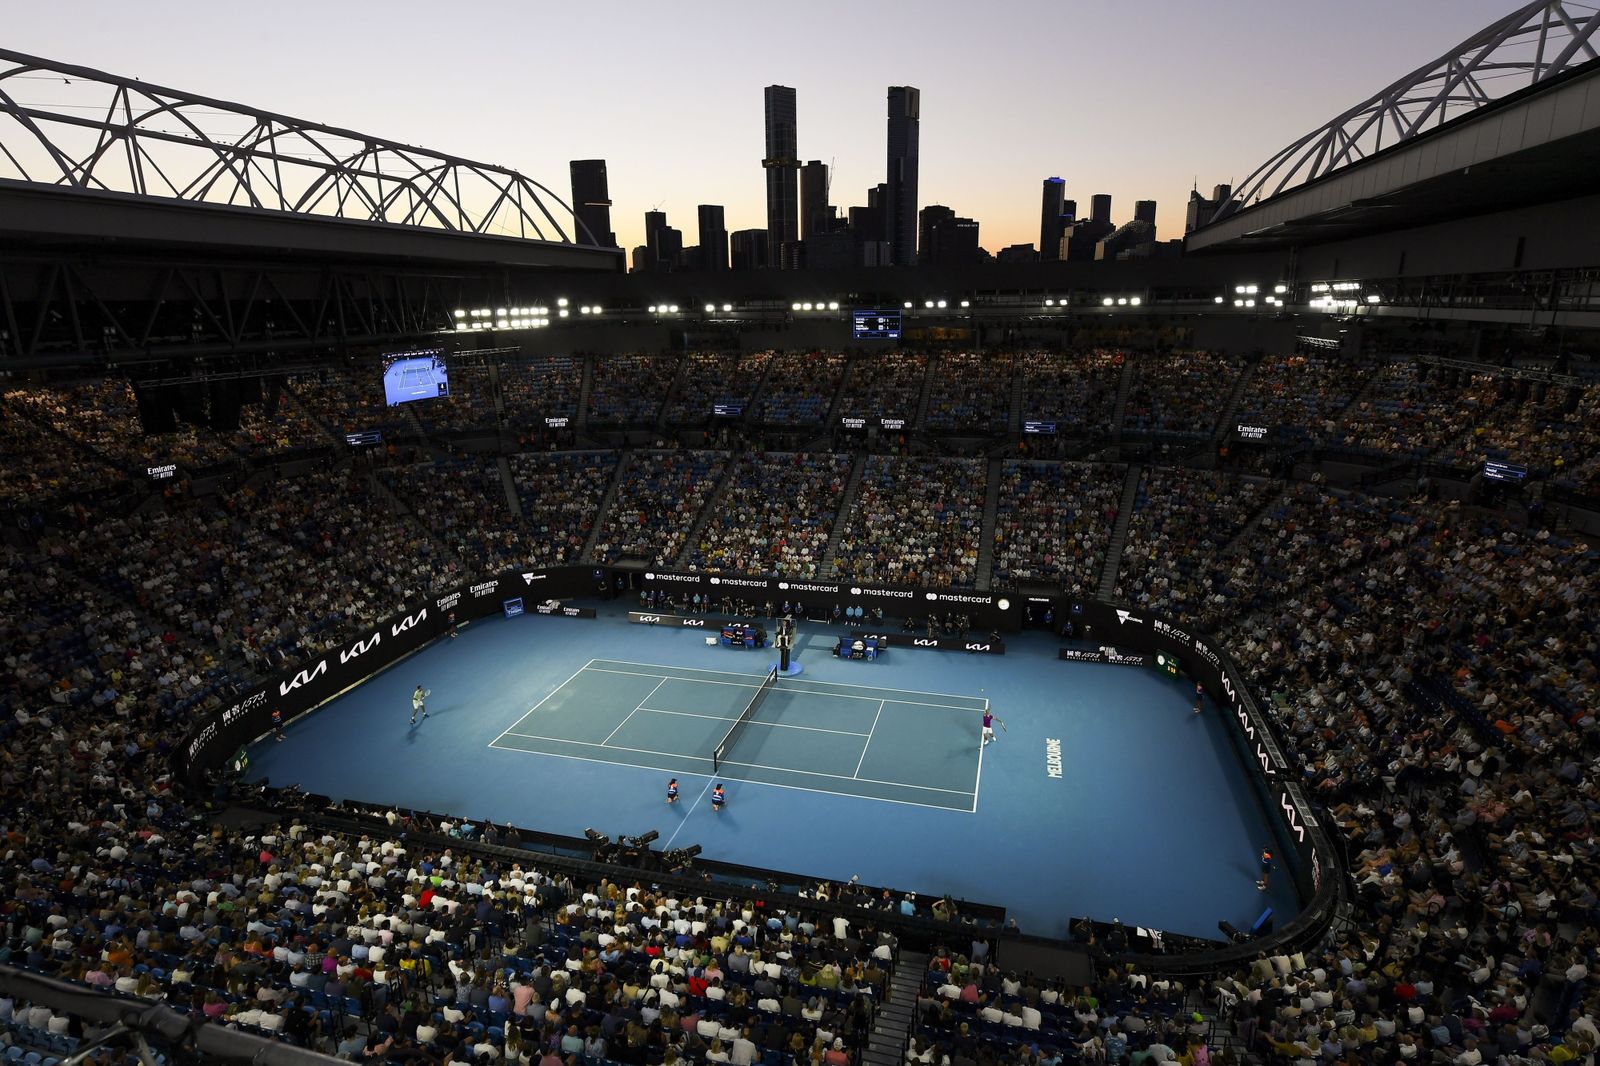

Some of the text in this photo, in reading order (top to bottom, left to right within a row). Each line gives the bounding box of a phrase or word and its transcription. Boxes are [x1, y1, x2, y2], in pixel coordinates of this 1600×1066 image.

[1237, 425, 1268, 434] Emirates
[147, 464, 177, 475] Emirates
[656, 573, 700, 582] mastercard
[722, 578, 767, 587] mastercard
[470, 580, 499, 593] Emirates
[790, 583, 838, 592] mastercard
[863, 588, 913, 598] mastercard
[939, 593, 991, 603] mastercard
[436, 592, 461, 607] Emirates
[392, 608, 427, 637] KIA
[640, 615, 660, 623] KIA
[340, 632, 381, 664] KIA
[914, 638, 938, 647] KIA
[965, 643, 990, 651] KIA
[279, 659, 327, 696] KIA
[1221, 671, 1235, 702] KIA
[1238, 704, 1254, 740] KIA
[1046, 737, 1063, 778] MELBOURNE
[1281, 792, 1305, 842] KIA
